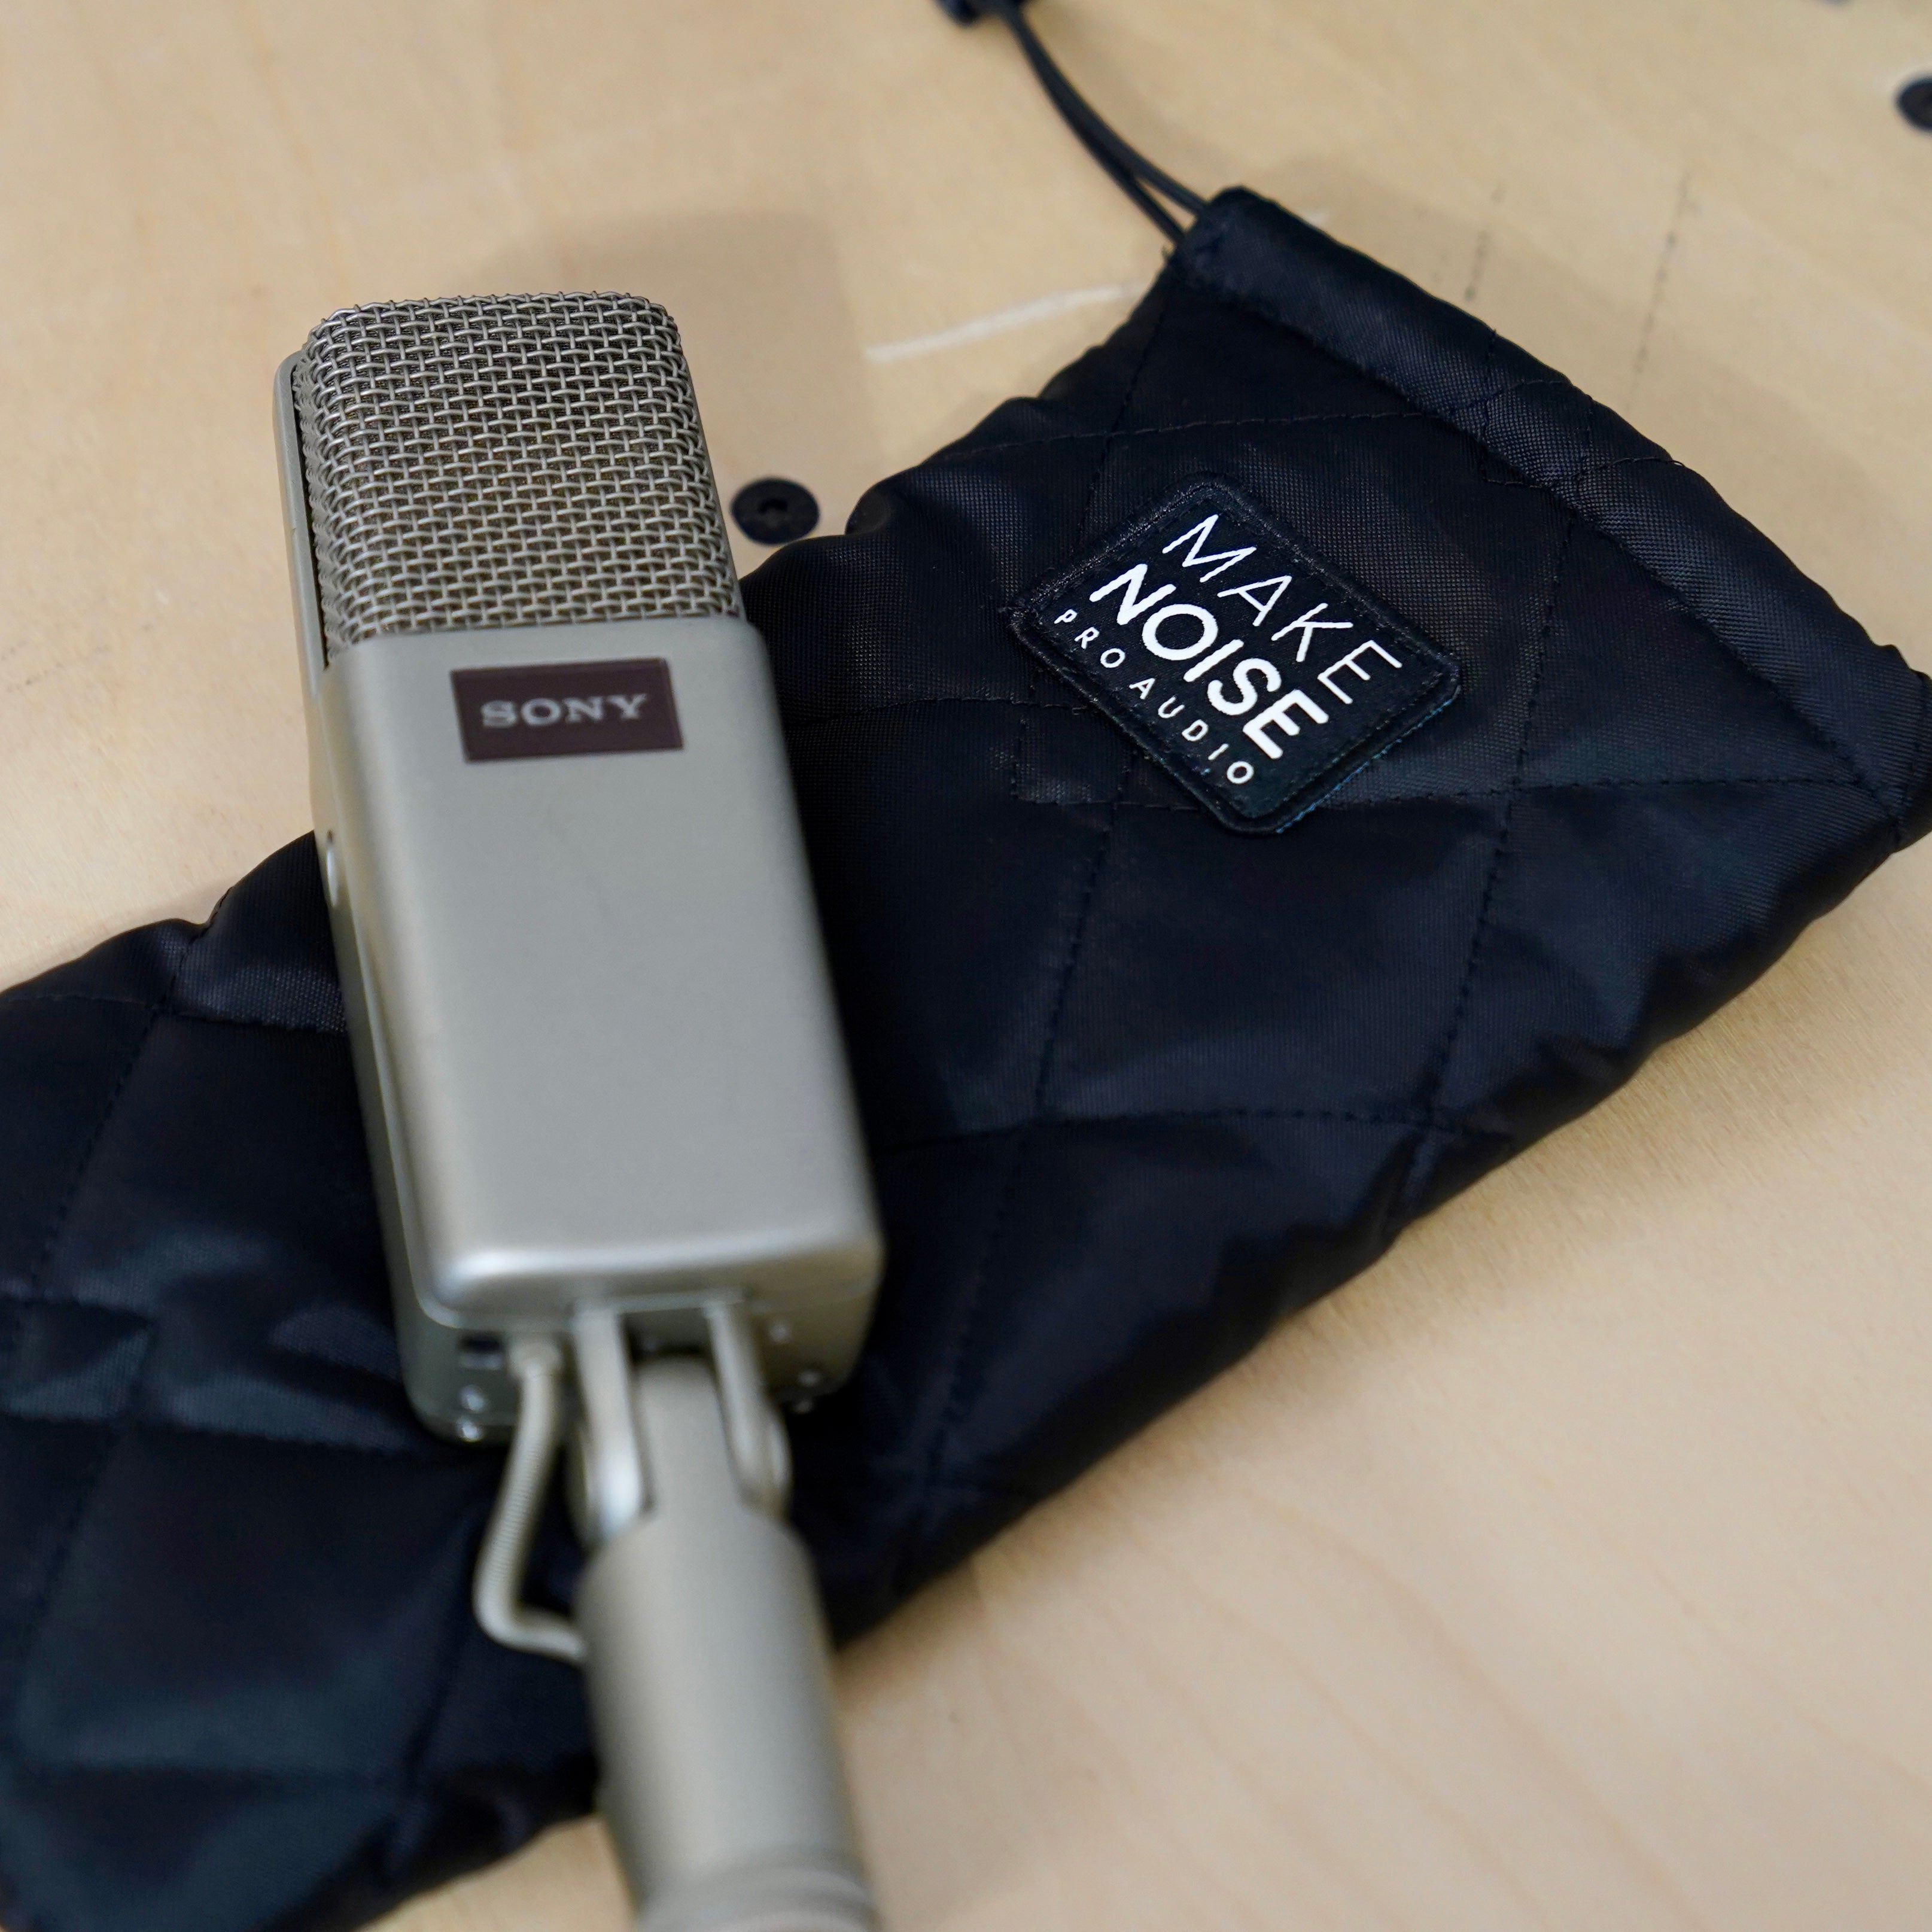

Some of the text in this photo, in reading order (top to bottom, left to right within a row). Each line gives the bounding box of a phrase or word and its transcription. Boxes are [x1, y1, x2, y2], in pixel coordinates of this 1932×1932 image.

[1054, 608, 1254, 784] PRO AUDIO
[1089, 563, 1329, 759] NOISE
[1162, 514, 1402, 704] MAKE
[480, 693, 647, 726] SONY
